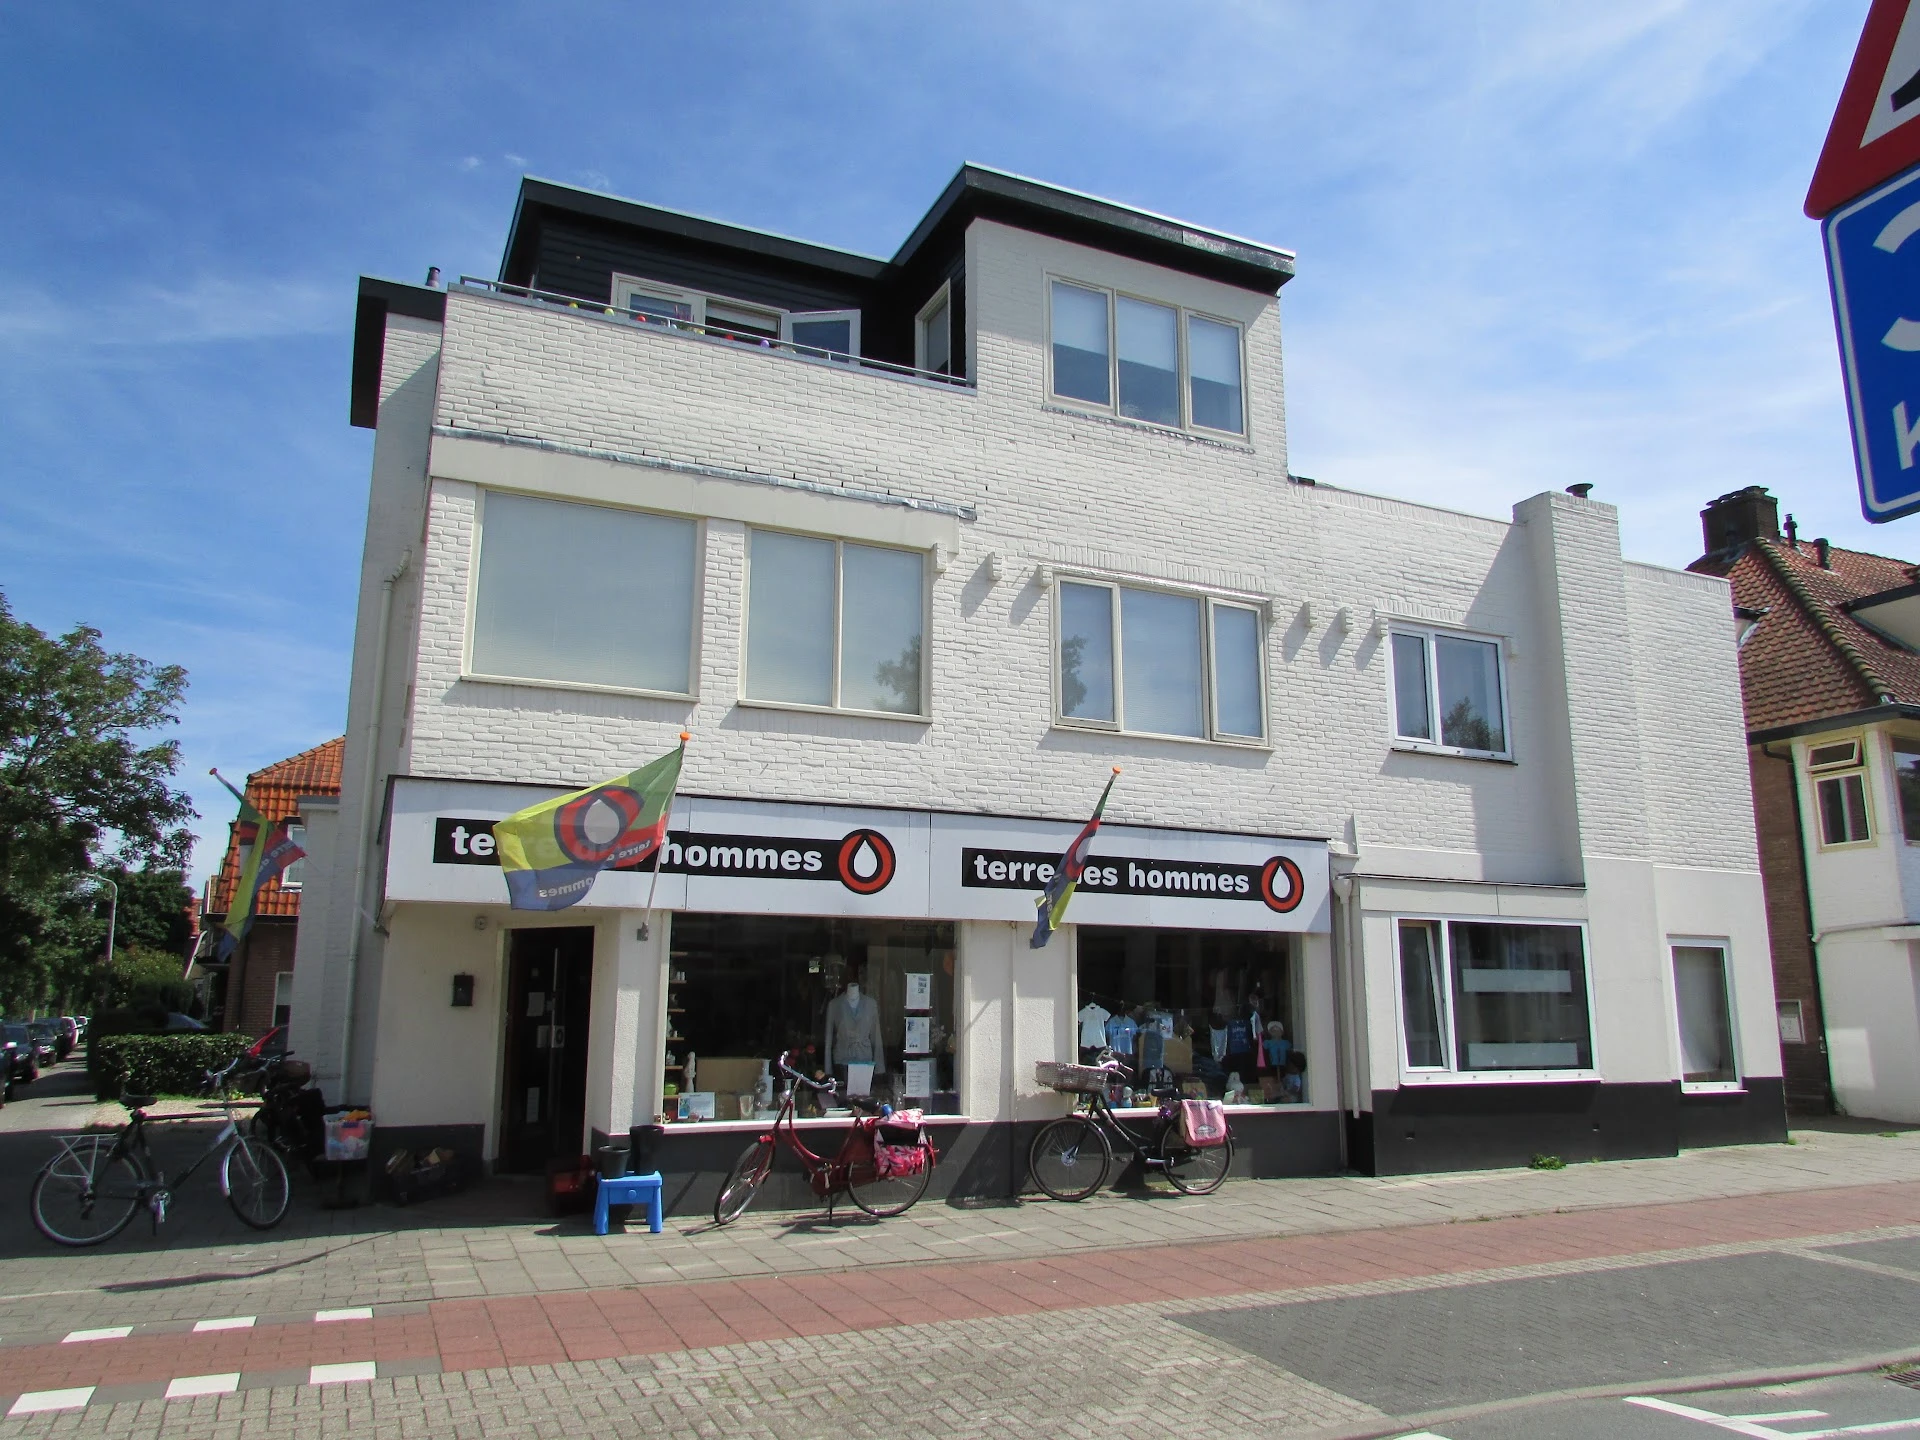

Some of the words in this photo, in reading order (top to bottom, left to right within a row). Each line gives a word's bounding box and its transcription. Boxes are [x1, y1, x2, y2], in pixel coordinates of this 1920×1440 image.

[661, 835, 823, 872] hommes
[973, 854, 1055, 883] terre
[1076, 864, 1119, 887] es
[1128, 862, 1250, 893] hommes
